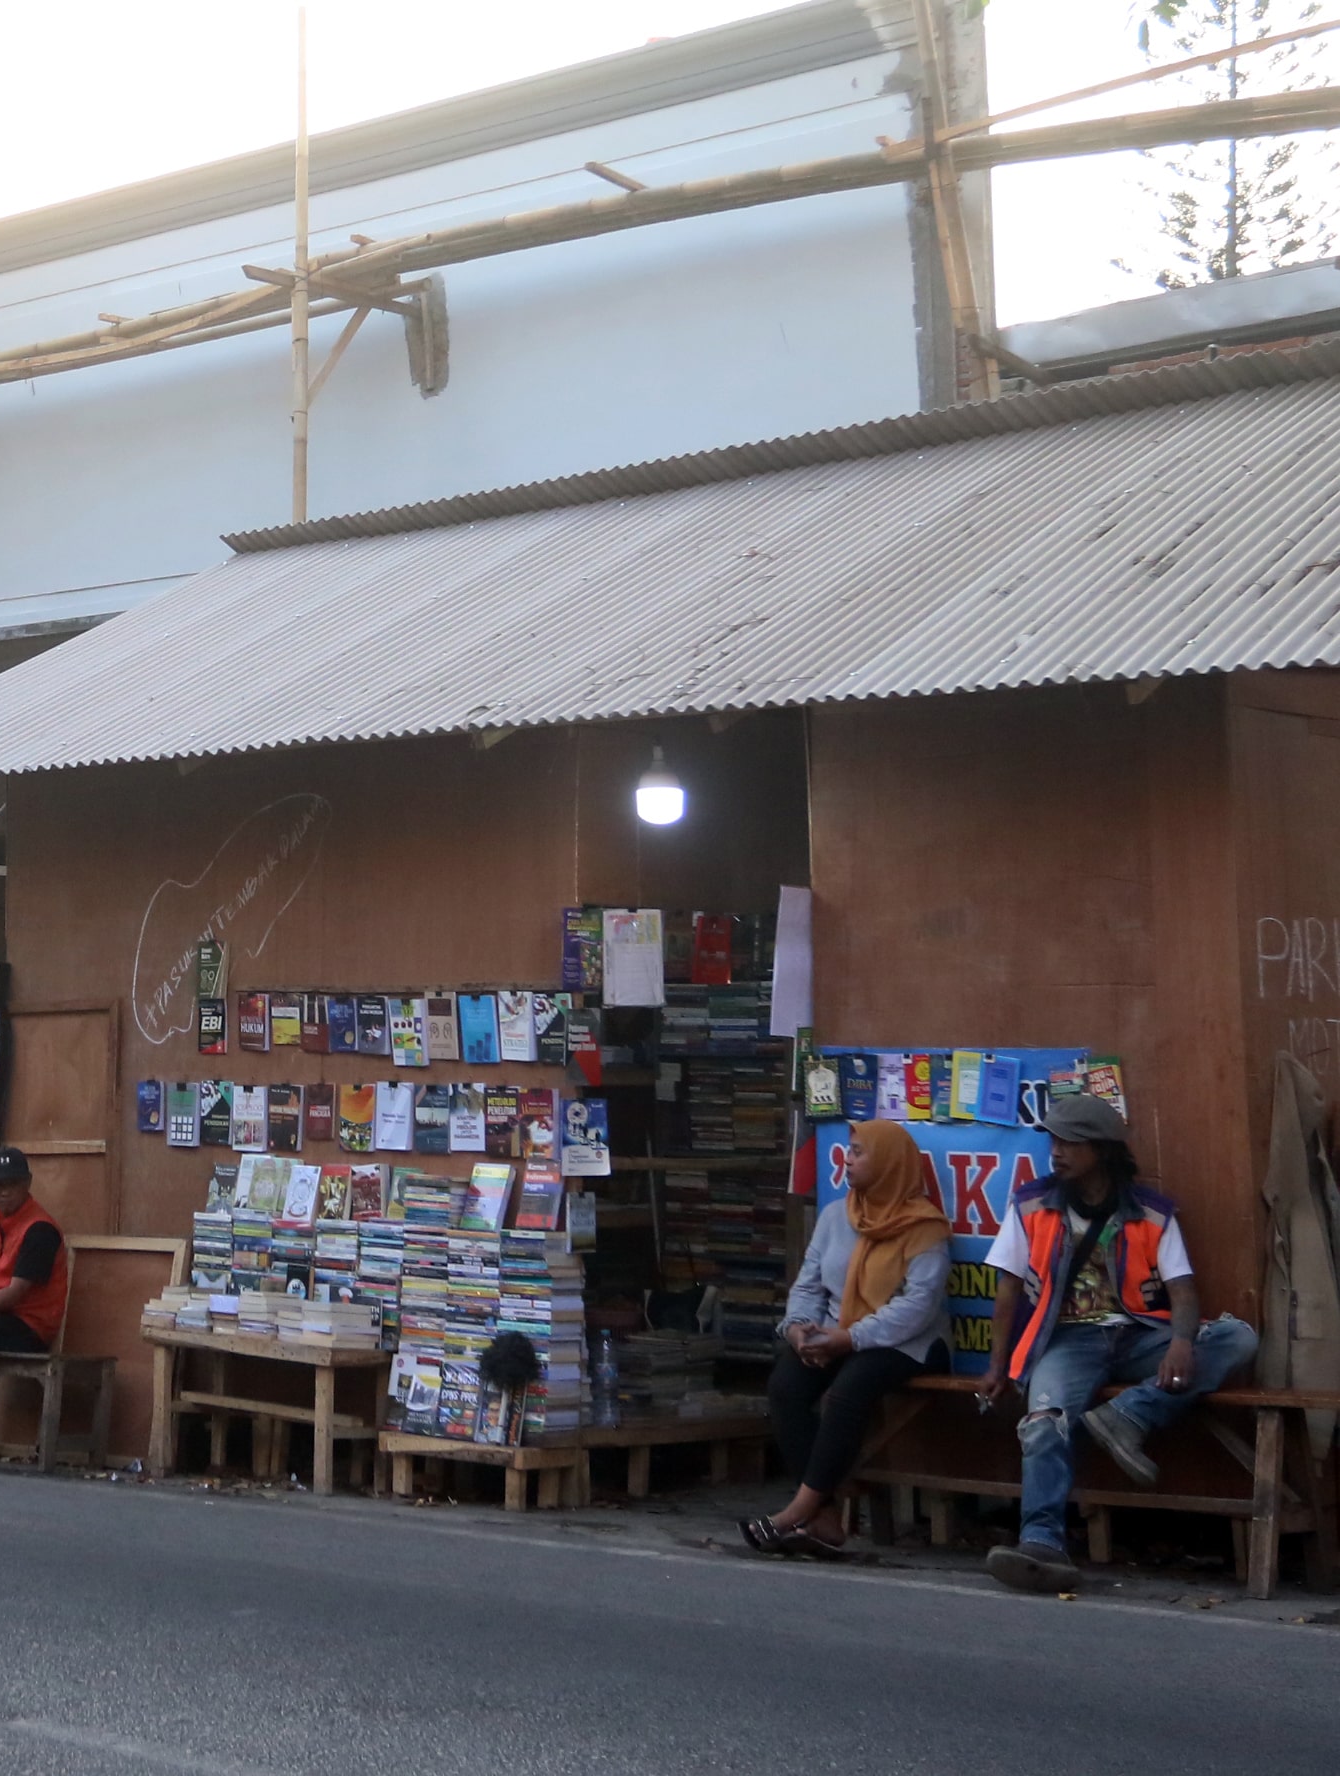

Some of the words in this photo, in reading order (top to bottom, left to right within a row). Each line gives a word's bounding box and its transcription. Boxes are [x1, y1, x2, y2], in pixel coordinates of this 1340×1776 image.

[1256, 916, 1340, 1002] PAR
[201, 1015, 223, 1030] EBI
[240, 1023, 264, 1034] HUKUM
